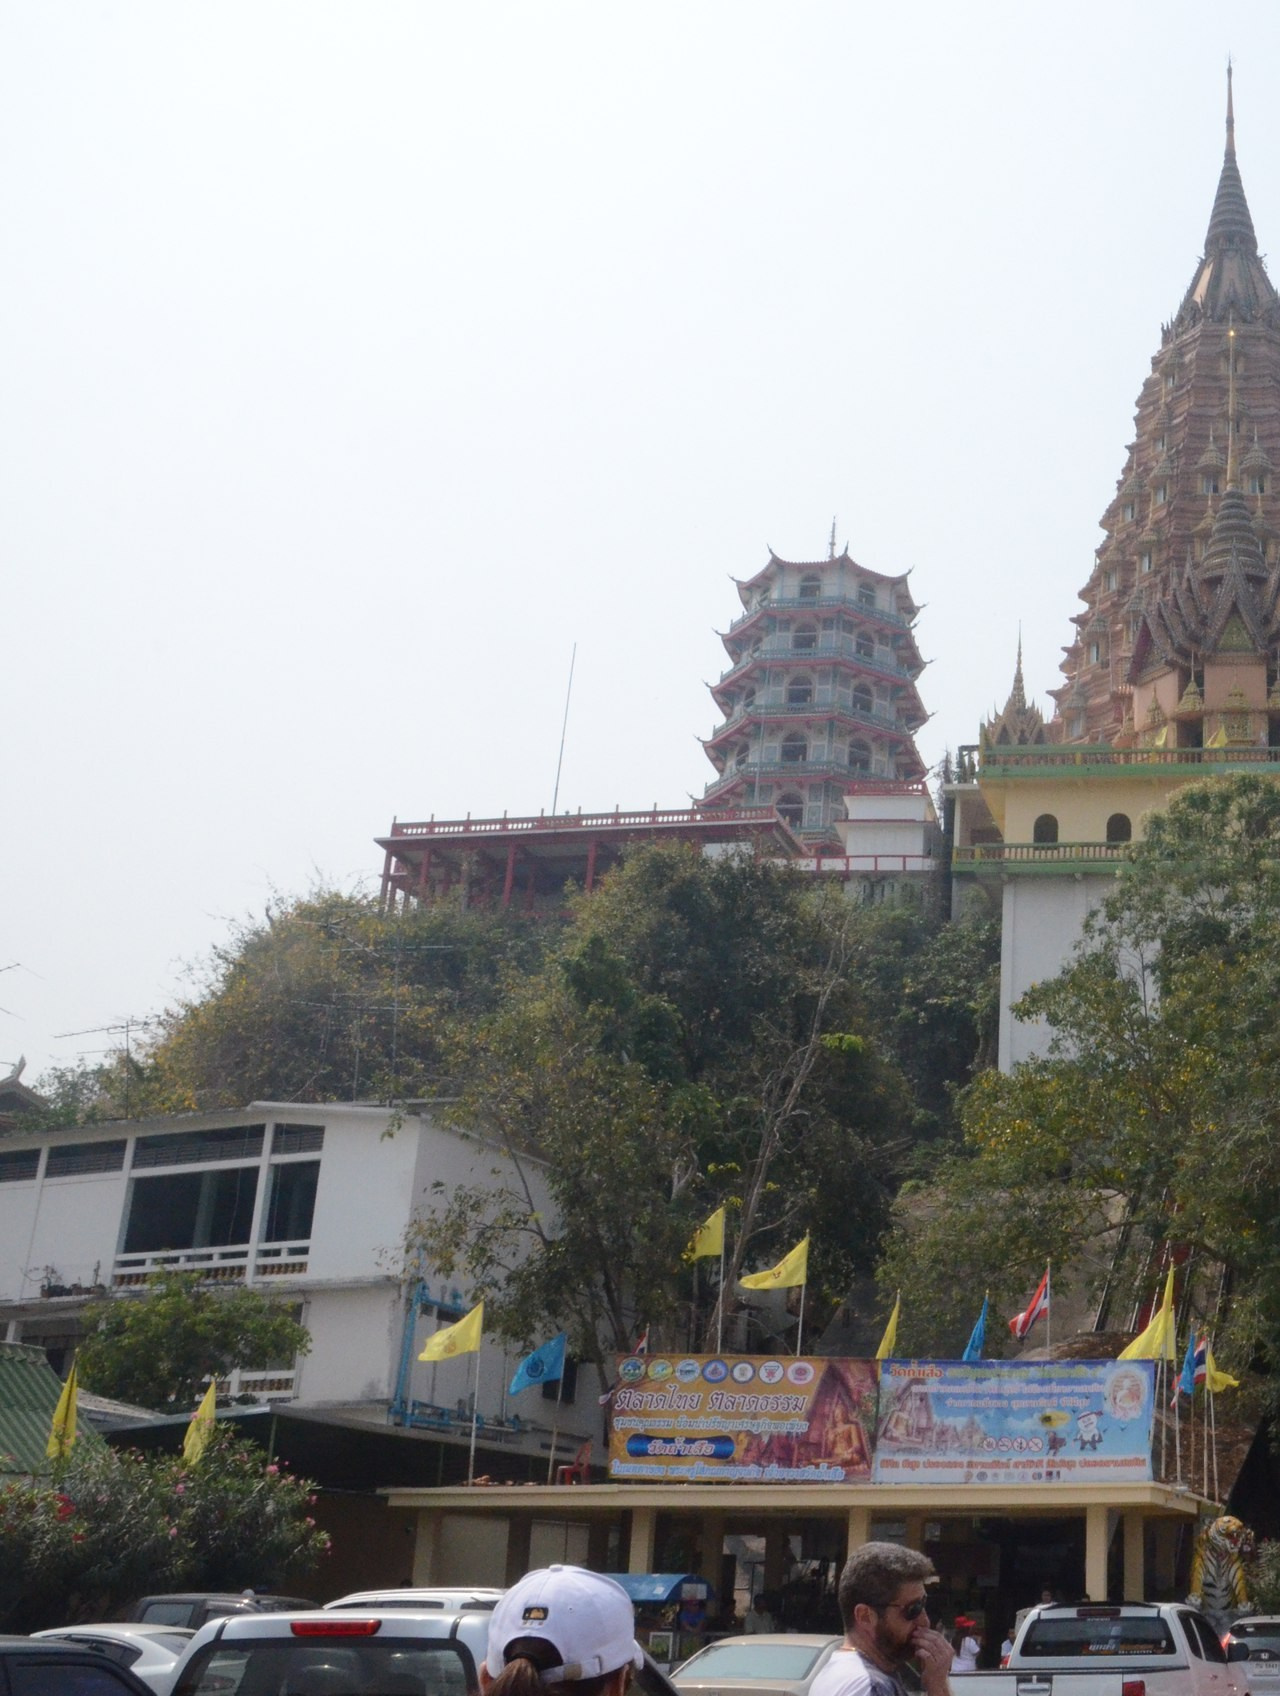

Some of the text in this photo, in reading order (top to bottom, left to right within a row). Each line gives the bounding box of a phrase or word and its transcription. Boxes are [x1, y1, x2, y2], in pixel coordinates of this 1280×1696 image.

[615, 1384, 702, 1411] ตลาดไทย
[647, 1436, 715, 1455] วัดถ้ำเสือ
